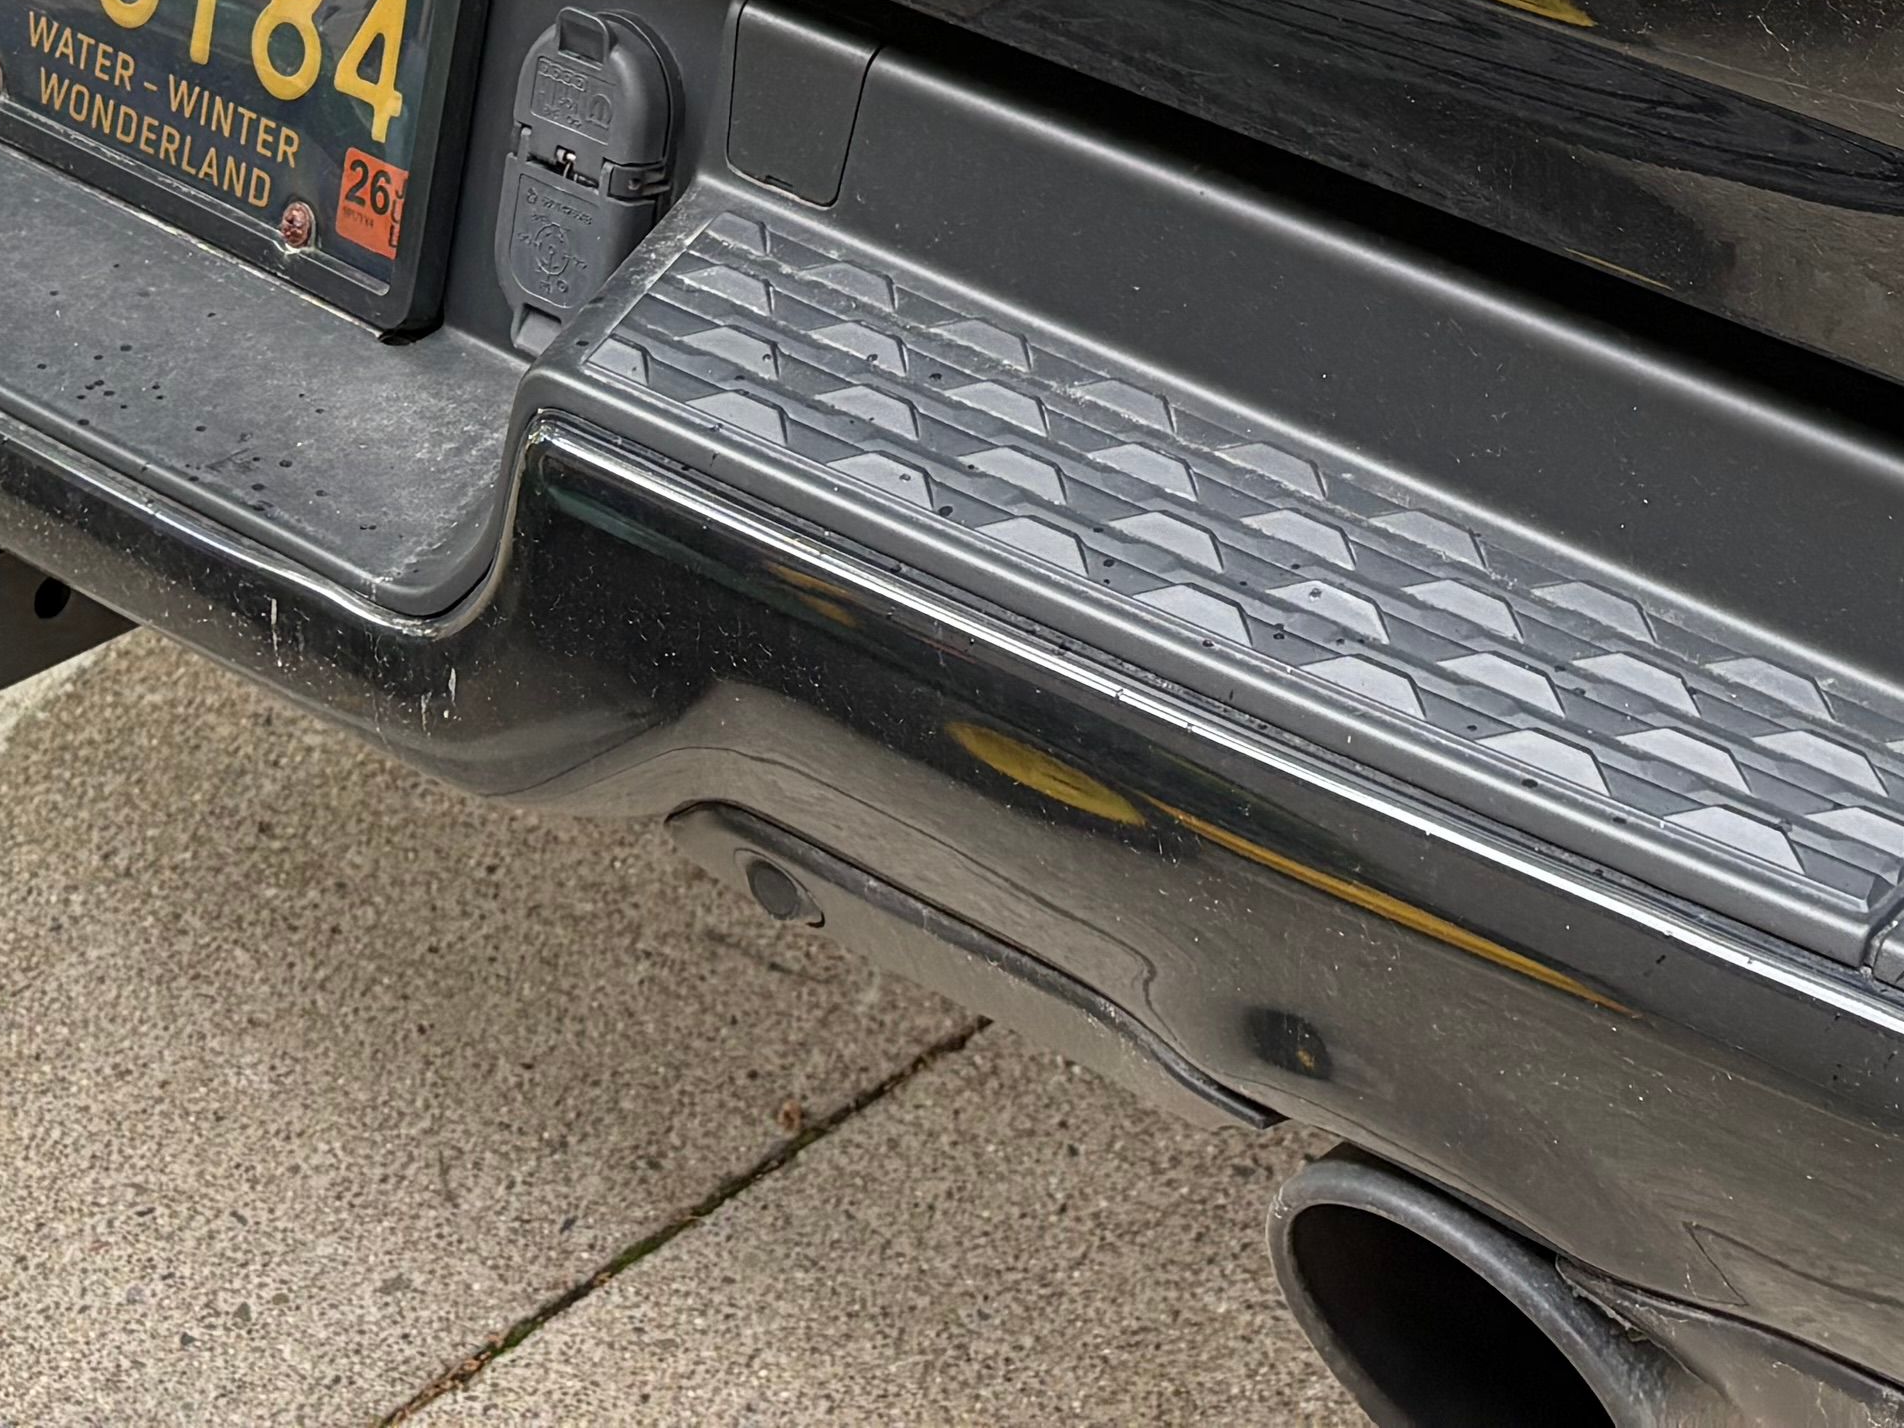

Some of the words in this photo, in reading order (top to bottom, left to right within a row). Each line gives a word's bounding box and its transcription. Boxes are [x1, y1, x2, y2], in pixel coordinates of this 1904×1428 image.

[28, 10, 134, 93] WATER
[168, 73, 300, 169] WINTER
[38, 66, 272, 209] WONDERLAND
[345, 159, 392, 216] 26
